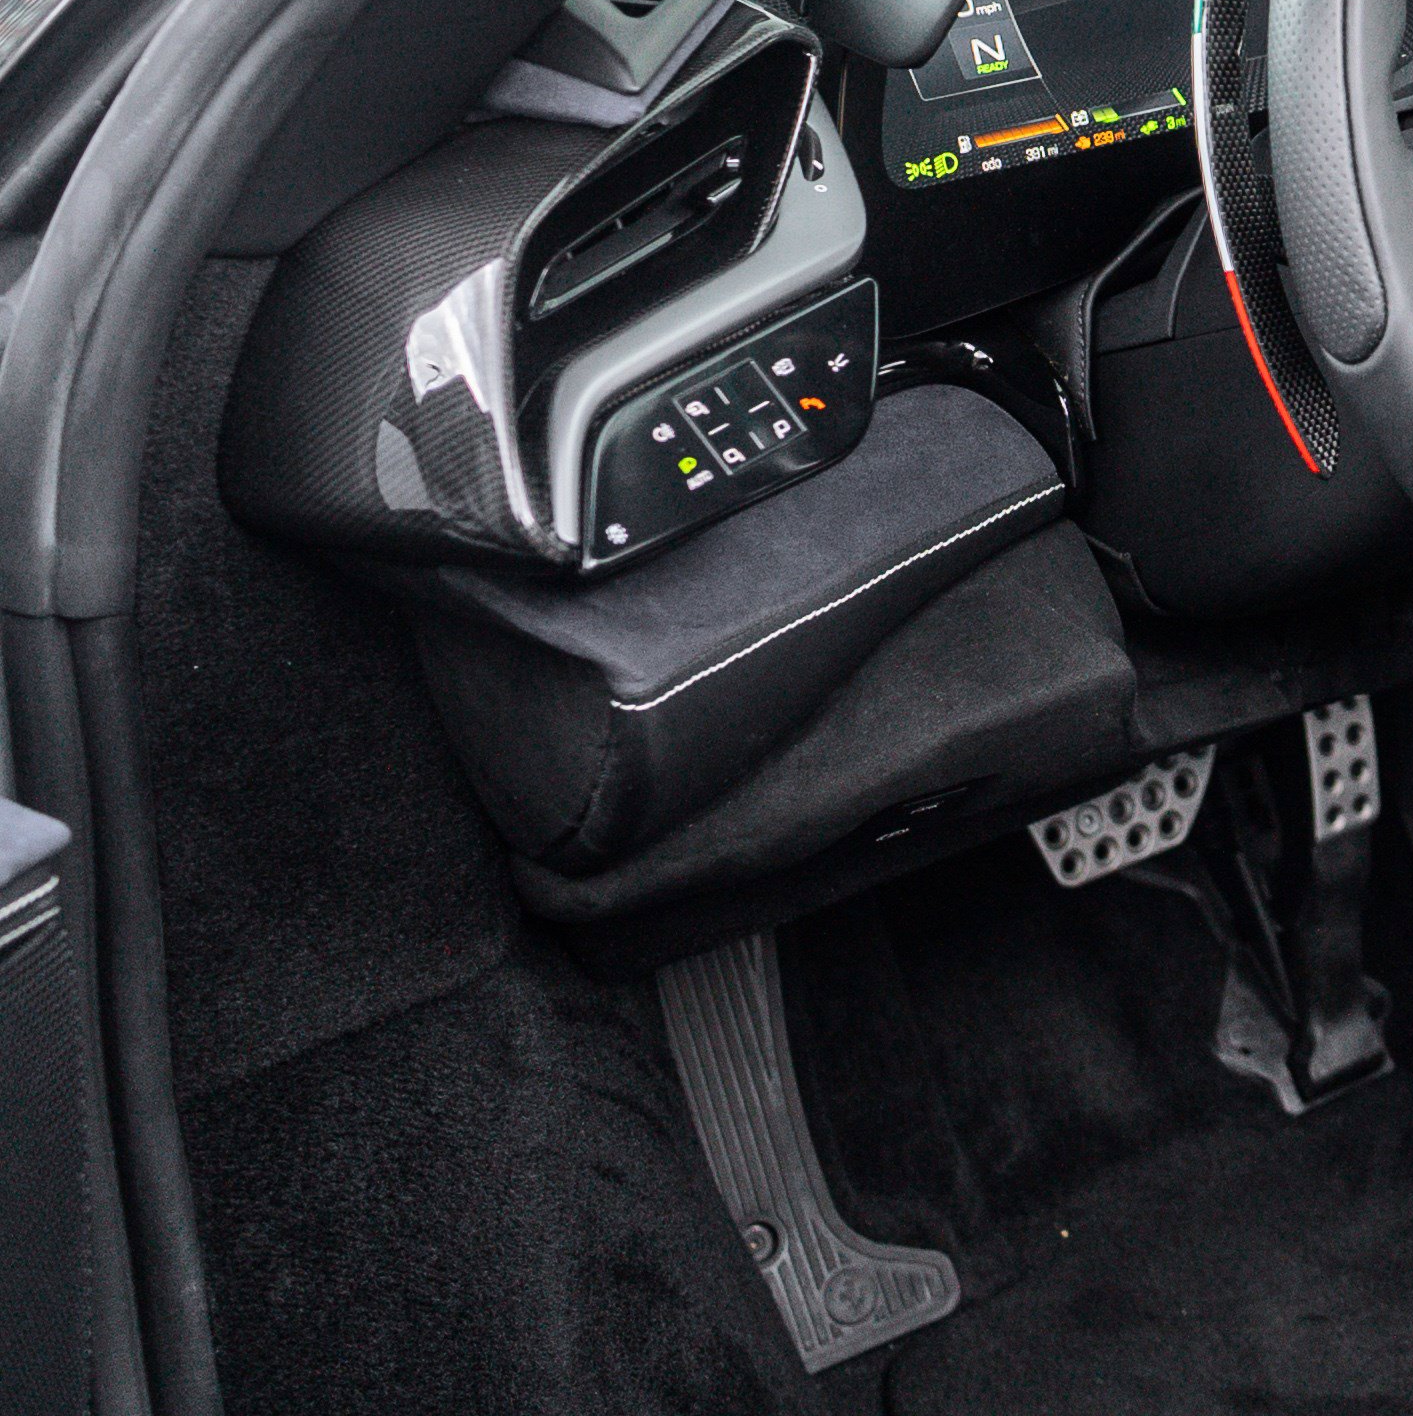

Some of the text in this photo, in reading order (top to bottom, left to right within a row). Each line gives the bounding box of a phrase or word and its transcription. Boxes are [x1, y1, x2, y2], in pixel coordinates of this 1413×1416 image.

[975, 1, 1002, 16] mph
[971, 34, 1006, 65] N
[976, 59, 1009, 74] READY
